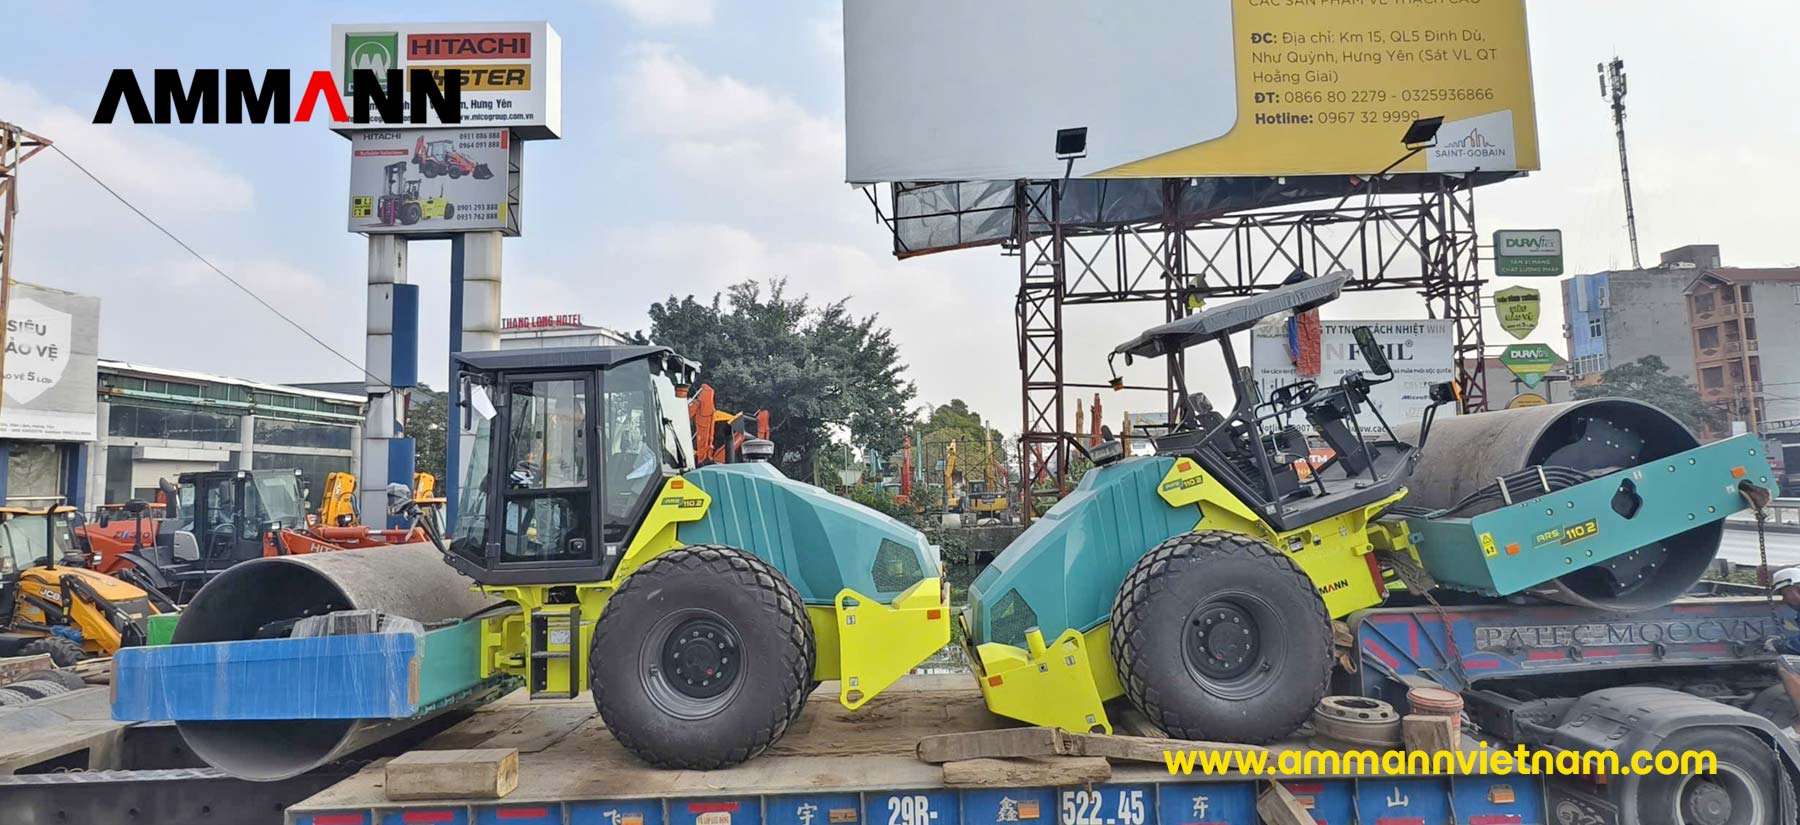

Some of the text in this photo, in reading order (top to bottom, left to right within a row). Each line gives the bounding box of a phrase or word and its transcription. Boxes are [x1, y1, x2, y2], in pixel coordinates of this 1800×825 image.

[1250, 32, 1277, 44] ĐC:
[1282, 32, 1306, 46] Địa
[1340, 32, 1363, 43] Km
[1368, 31, 1385, 44] 15,
[1390, 30, 1420, 42] QL5
[412, 38, 526, 56] HITACHI
[1252, 48, 1496, 65] Như Quỳnh, Hưng Yên (Sát VL QT
[432, 69, 526, 86] YSTER
[1306, 70, 1338, 83] Giai)
[1254, 92, 1280, 103] ĐT:
[1284, 91, 1322, 103] 0866
[1328, 91, 1346, 103] 80
[1352, 90, 1386, 102] 2279
[1402, 88, 1494, 101] 0325936866
[496, 99, 512, 108] Yên
[460, 112, 534, 121] w.micogroup.com.vn
[1255, 110, 1420, 124] Hotline: 0967 32 9999
[1435, 149, 1505, 157] SAINT-GOBAIN
[7, 320, 46, 336] SIÊU
[532, 316, 552, 328] LONG
[556, 314, 581, 327] HOTEL
[1370, 323, 1392, 334] CÁCH
[1396, 323, 1424, 336] NHIỆT
[1426, 326, 1445, 334] WIN
[5, 336, 58, 361] ẢO VỆ
[1536, 529, 1559, 542] ARS
[41, 588, 60, 601] JCB
[1318, 579, 1348, 595] MANN
[997, 795, 1018, 821] 鑫
[1387, 786, 1408, 808] 山
[1062, 790, 1144, 825] 522.45
